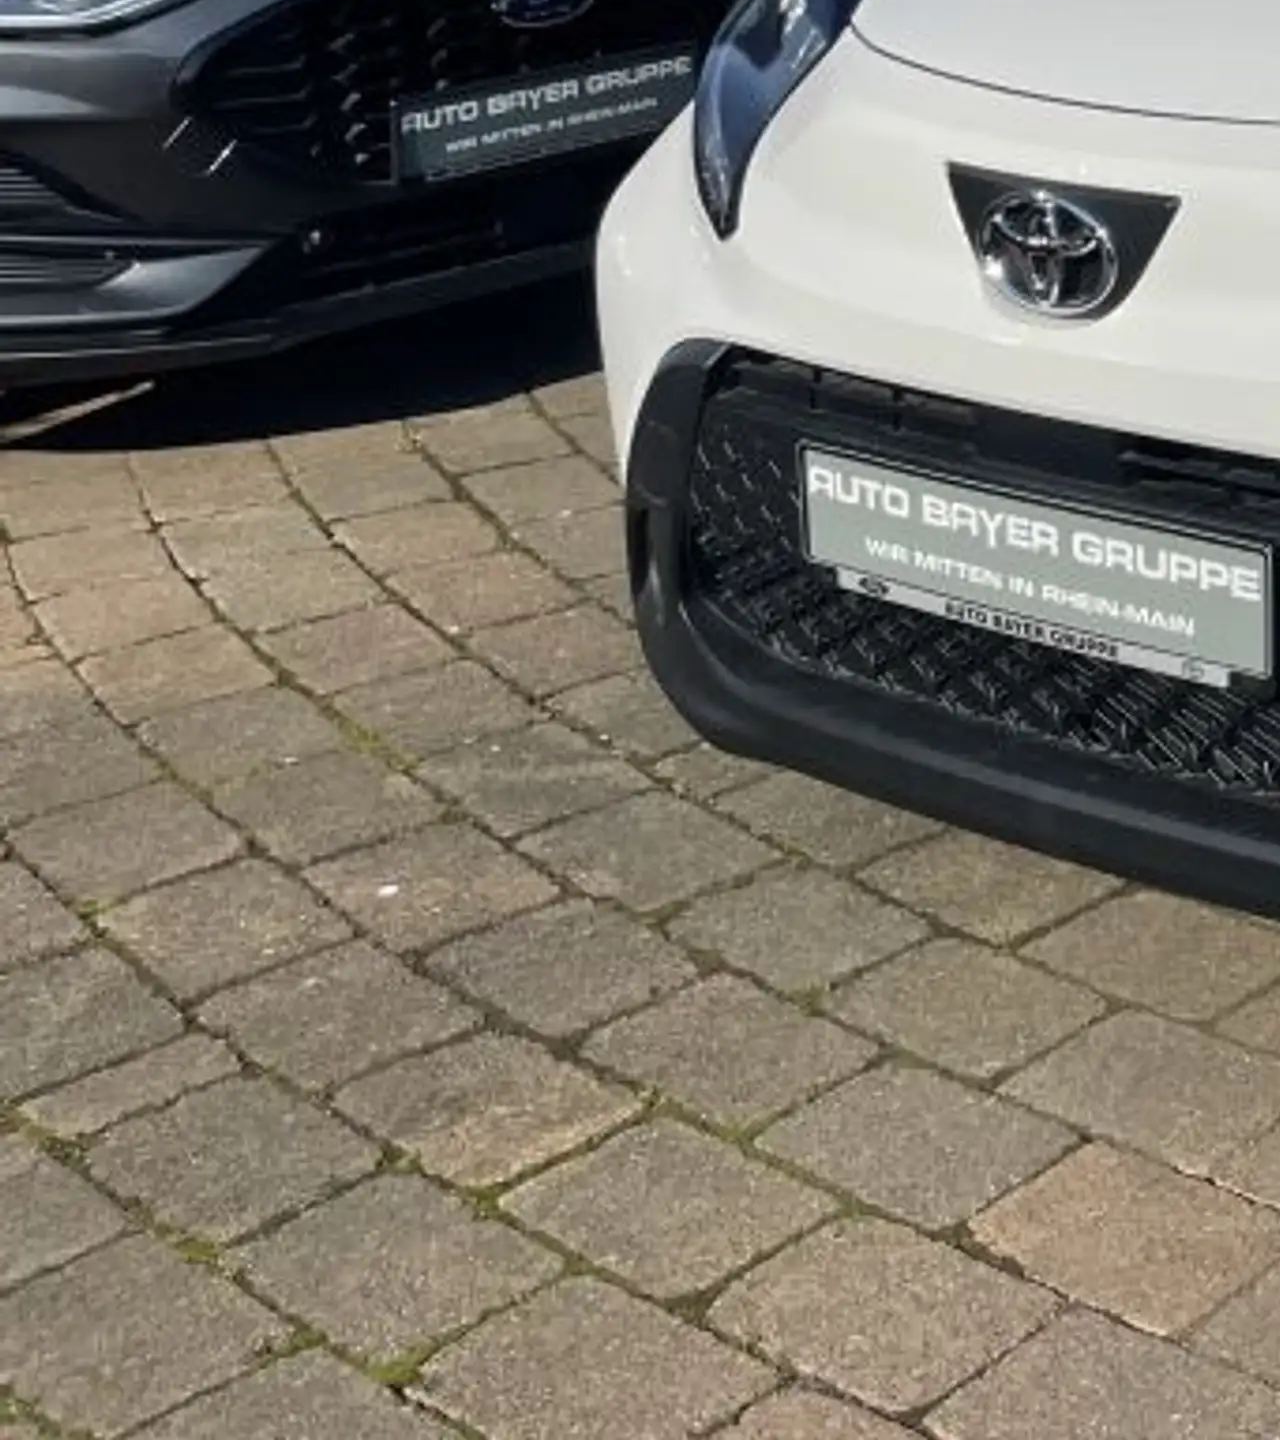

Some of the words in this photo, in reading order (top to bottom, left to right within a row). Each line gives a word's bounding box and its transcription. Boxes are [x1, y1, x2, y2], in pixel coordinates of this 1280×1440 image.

[401, 100, 478, 134] AUTO
[487, 79, 579, 115] BAYER
[584, 56, 692, 96] GRUPPE
[808, 464, 910, 519] AUTO
[922, 493, 1060, 558] BAYER
[1072, 531, 1262, 602] GRUPPE
[864, 535, 909, 565] WIR
[914, 550, 1003, 591] MITTEN
[1008, 576, 1034, 599] IN
[945, 601, 988, 625] AUTO
[992, 613, 1043, 639] BAYER
